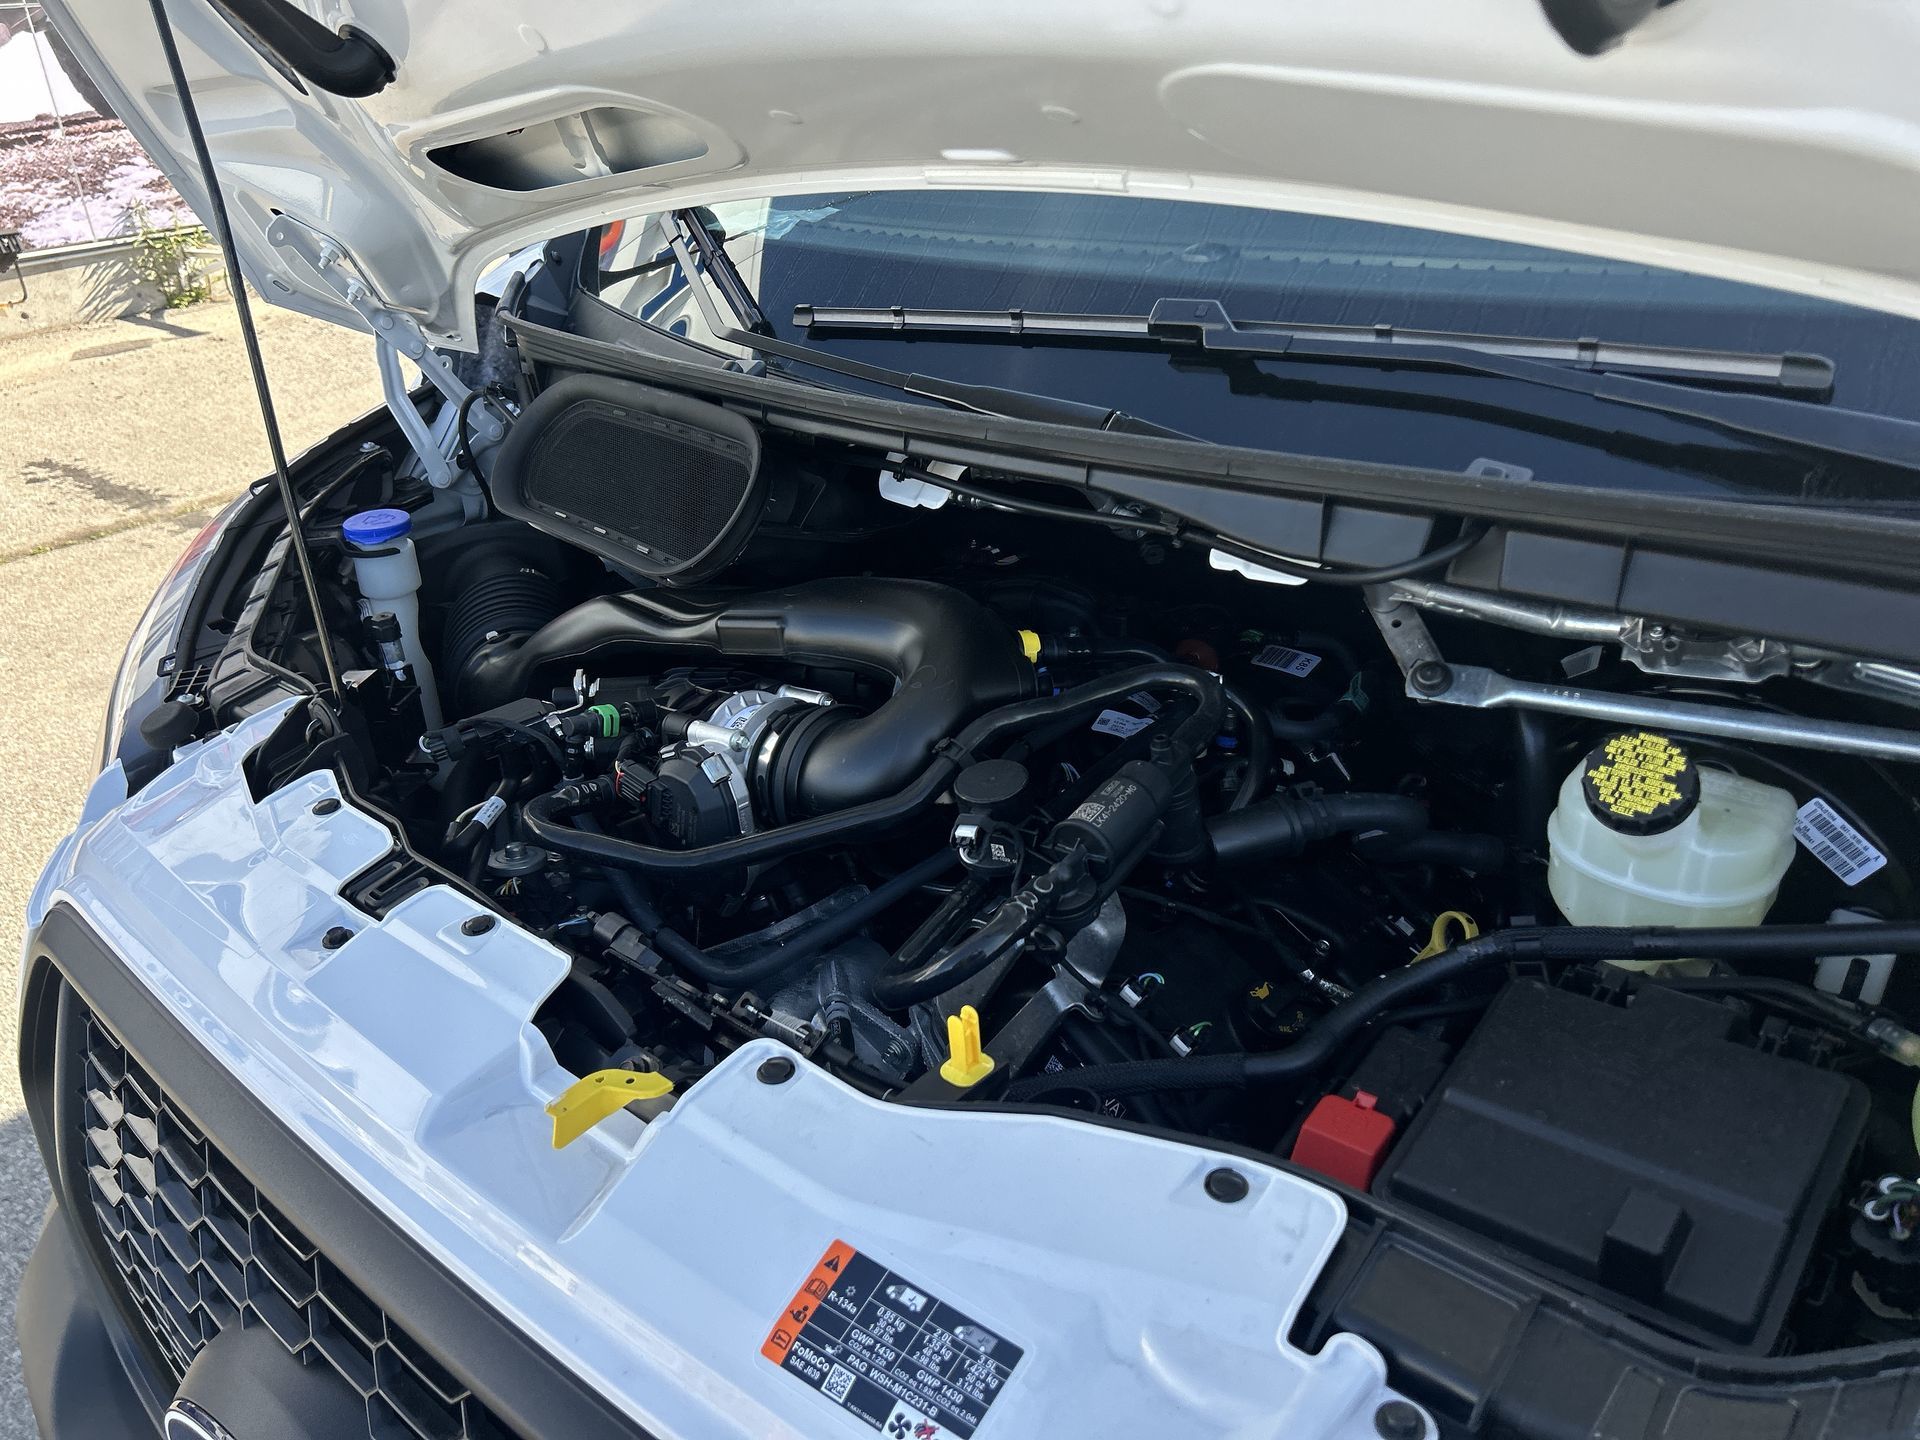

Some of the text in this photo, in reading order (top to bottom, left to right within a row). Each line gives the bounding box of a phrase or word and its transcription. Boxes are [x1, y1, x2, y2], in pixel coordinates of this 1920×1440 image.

[1295, 657, 1313, 671] K85
[1619, 735, 1681, 754] CLEAN FILLER CAP
[827, 1290, 858, 1313] R-134a
[876, 1306, 906, 1331] 0.85 kg
[876, 1319, 894, 1333] 30 oz
[868, 1323, 894, 1342] 1.87 lbs
[933, 1328, 954, 1344] 2.0L
[848, 1339, 886, 1366] CO2 eq 1.22t
[850, 1328, 895, 1360] GWP 1430
[922, 1335, 953, 1359] 1.35 kg
[922, 1346, 941, 1362] 48 oz
[789, 1355, 820, 1379] SAE J639
[791, 1341, 831, 1371] FoMoCo
[913, 1351, 940, 1371] 2.98 lbs
[977, 1355, 998, 1371] 3.5L
[894, 1368, 908, 1380] CO2
[908, 1377, 917, 1387] eq
[963, 1359, 999, 1388] 1.425 kg
[965, 1373, 985, 1389] 50 oz
[846, 1354, 937, 1416] PAG WSH-M1C231-B
[915, 1369, 963, 1403] GWP 1430
[956, 1378, 984, 1399] 3.14 lbs
[935, 1394, 976, 1423] CO2 eq 2.04t
